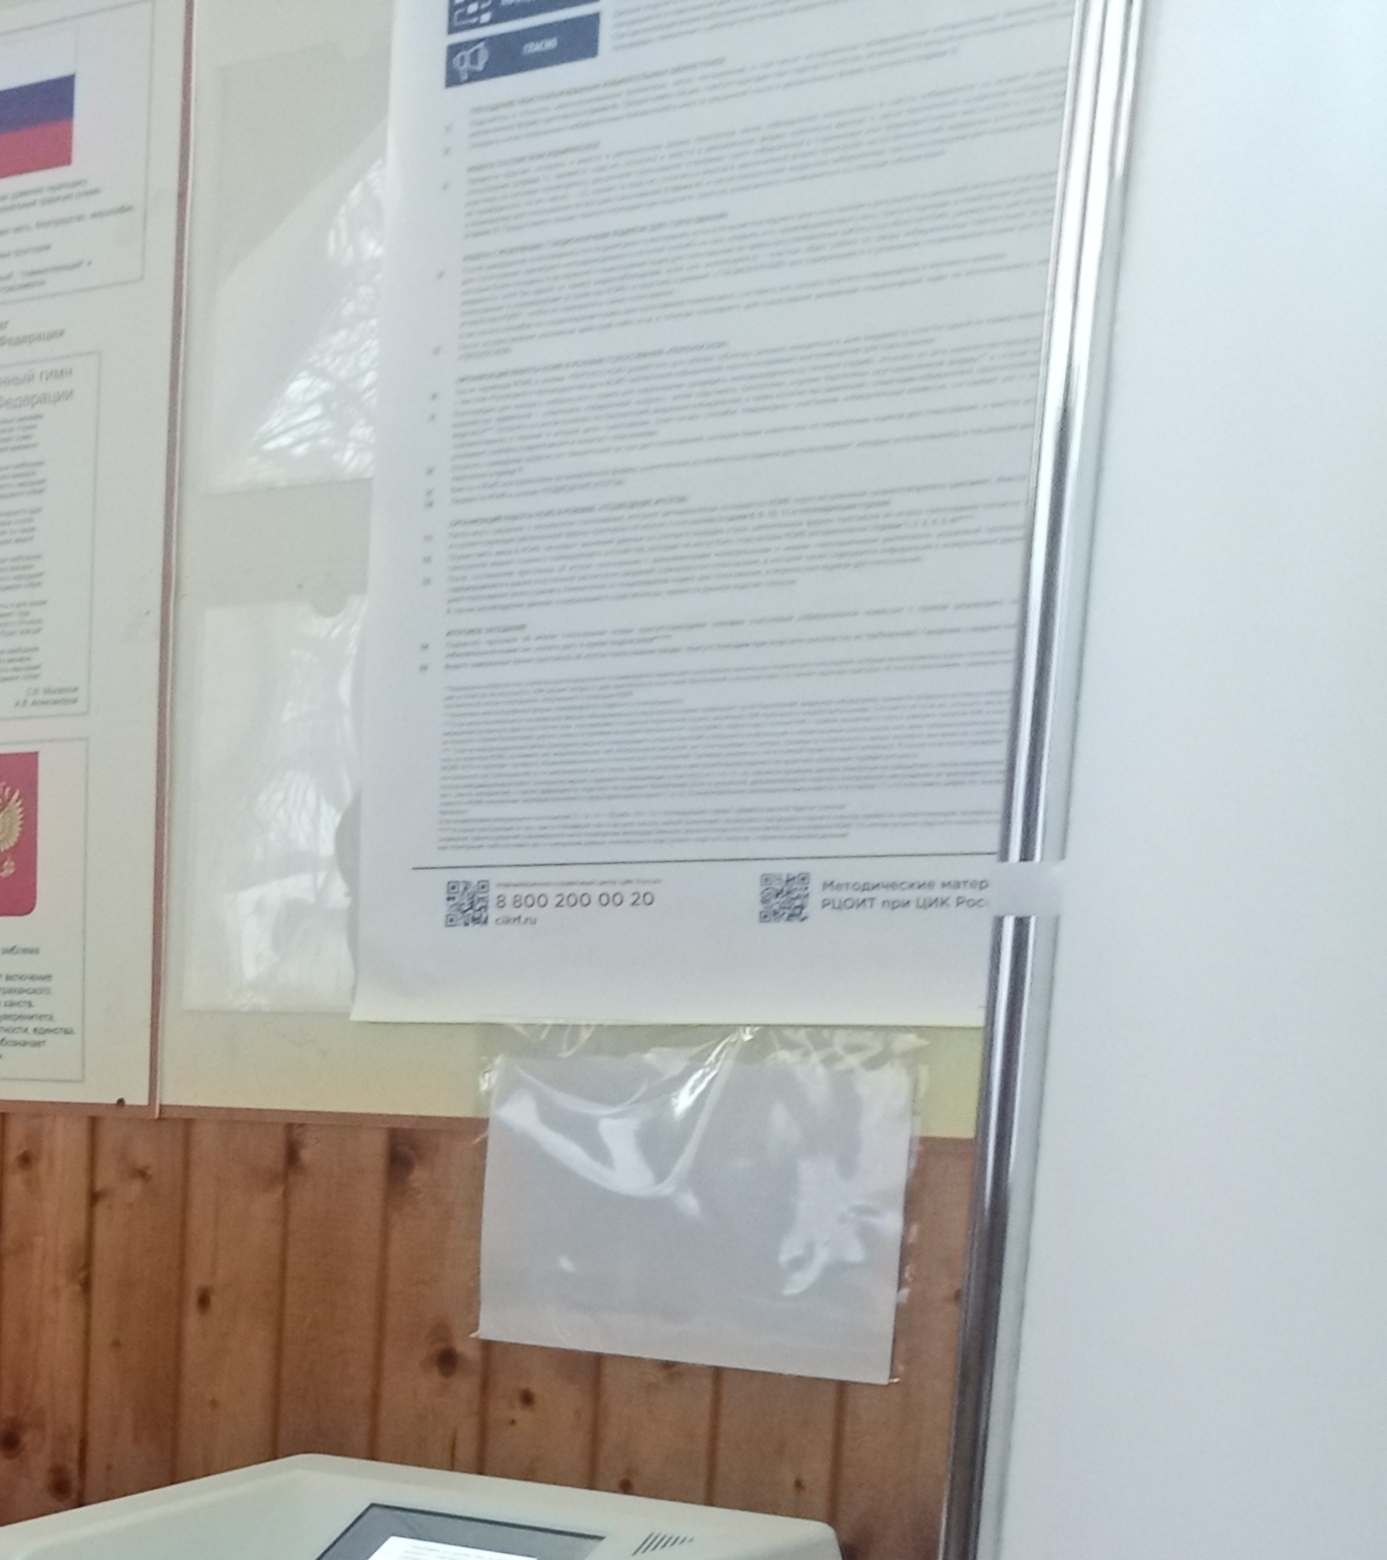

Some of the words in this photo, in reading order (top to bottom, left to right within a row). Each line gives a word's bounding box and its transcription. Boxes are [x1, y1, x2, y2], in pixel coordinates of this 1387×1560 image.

[821, 879, 936, 893] Методические
[496, 894, 507, 908] 8
[512, 893, 549, 909] 800
[554, 892, 592, 908] 200
[598, 891, 625, 907] 00
[630, 891, 655, 906] 20
[821, 897, 876, 911] РЦОИТ
[881, 899, 911, 911] при
[915, 896, 950, 910] ЦИК
